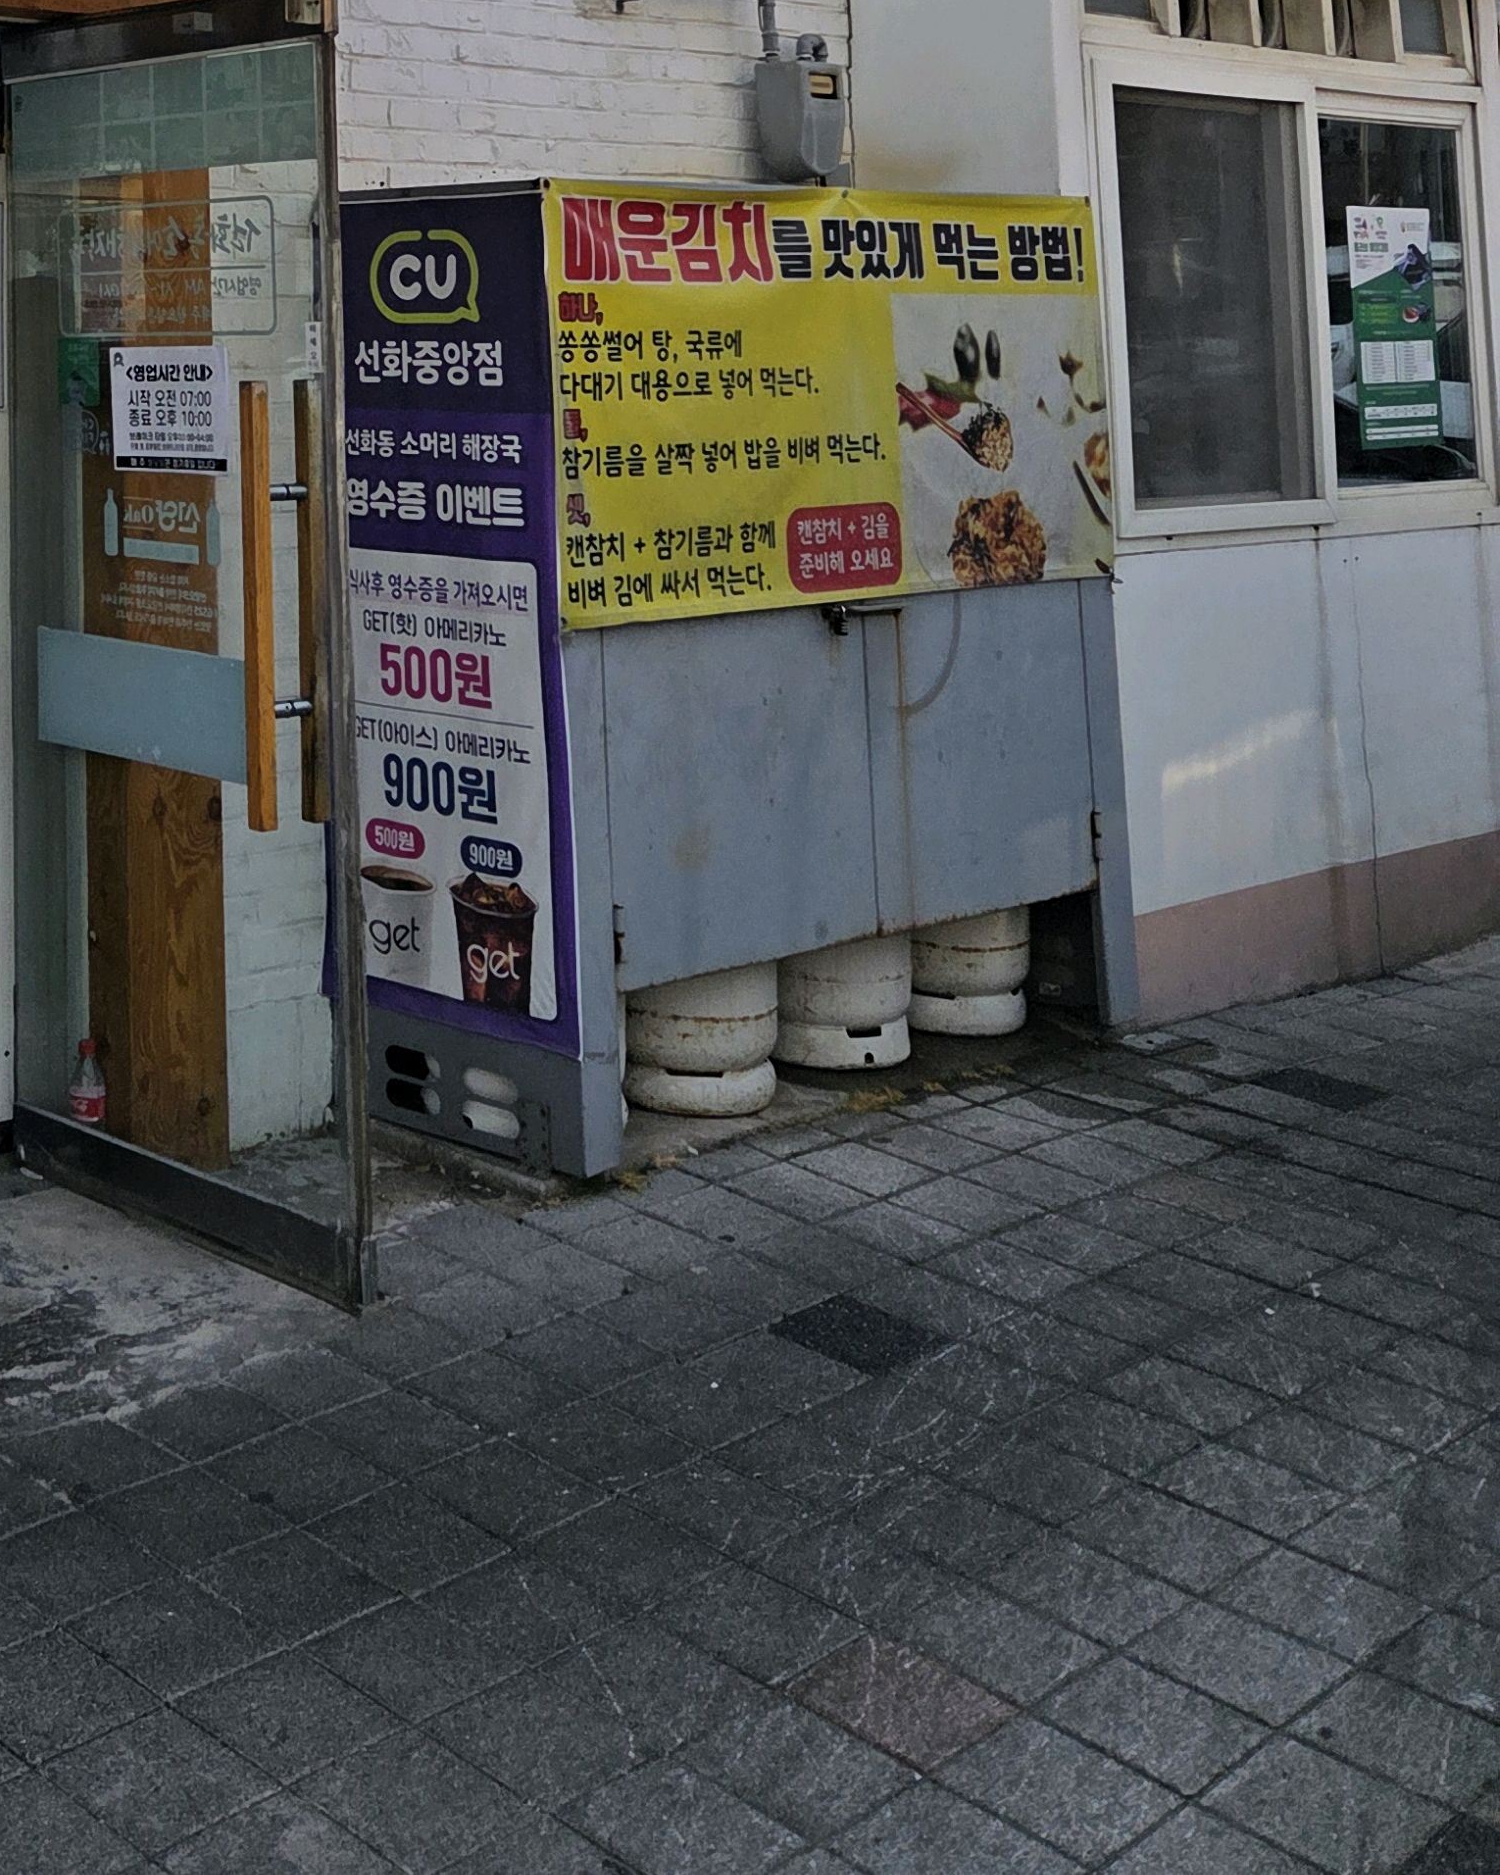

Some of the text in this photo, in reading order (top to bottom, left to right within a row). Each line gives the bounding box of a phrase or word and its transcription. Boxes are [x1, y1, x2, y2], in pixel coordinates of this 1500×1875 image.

[560, 196, 1085, 284] 매운김치를 맛있게 먹는 방법!
[389, 252, 457, 301] CU
[558, 291, 604, 326] 하나,
[354, 339, 505, 387] 선화중앙점
[651, 329, 679, 364] 탕,
[685, 328, 743, 360] 국류에
[127, 389, 213, 408] 시작 오전 07:00
[559, 366, 820, 403] 다대기 대용으로 넣어 먹는다.
[128, 409, 213, 427] 종료 오후 10:00
[345, 428, 523, 464] 선화동 소머리 해장국
[562, 432, 888, 480] 참기름을 살짝 넣어 밥을 비벼 먹는다.
[346, 478, 526, 527] 영수증 이벤트
[566, 519, 777, 569] 캔참치 참기름과 함께
[796, 512, 891, 546] 캔참치 김을
[850, 546, 894, 572] 오세요
[387, 572, 450, 604] 영수증을
[452, 580, 529, 612] 가져오시면
[567, 562, 773, 610] 비벼 김에 싸서 먹는다.
[362, 608, 507, 647] GET(핫) 아메리카노
[379, 642, 493, 710] 500원
[444, 729, 532, 765] 아메리카노
[382, 752, 499, 825] 900원
[373, 824, 515, 872] 500원 900원
[368, 916, 421, 955] get
[466, 941, 521, 984] get
